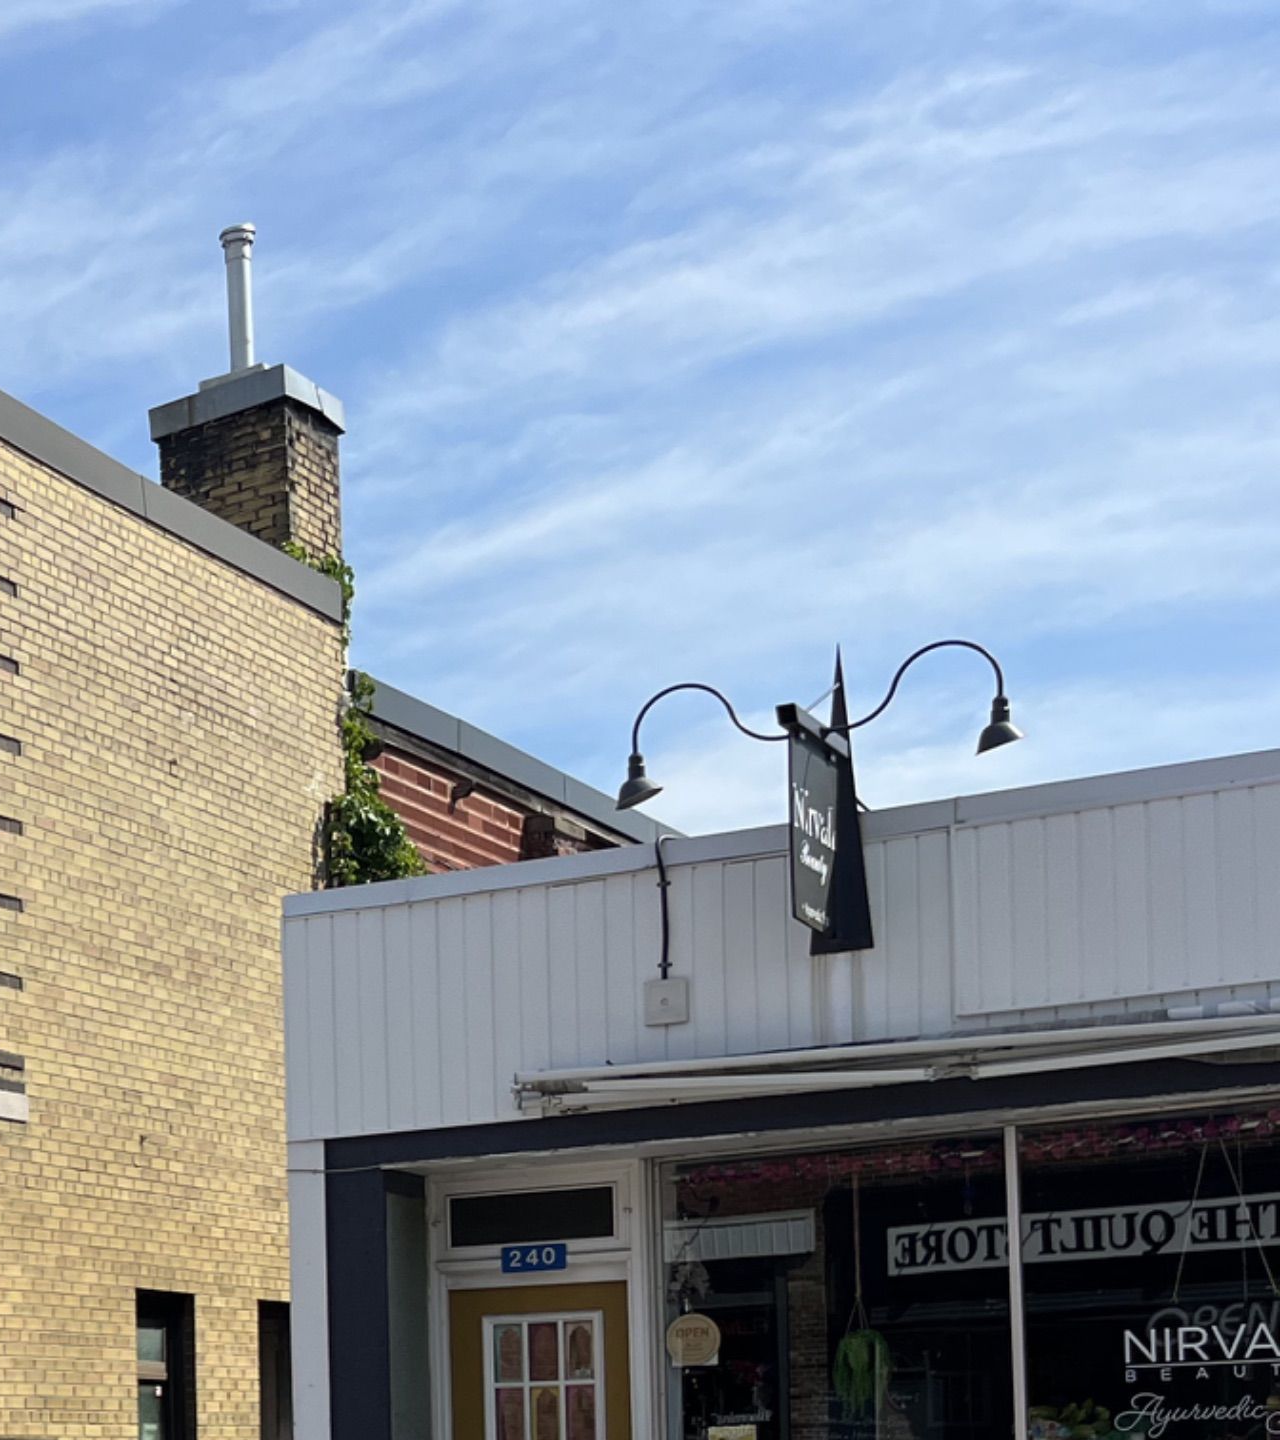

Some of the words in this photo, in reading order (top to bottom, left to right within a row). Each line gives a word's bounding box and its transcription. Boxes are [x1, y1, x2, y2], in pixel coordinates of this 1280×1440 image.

[509, 1246, 555, 1267] 240
[675, 1327, 709, 1338] OPEN
[1123, 1322, 1280, 1363] NIRVA
[1125, 1364, 1280, 1383] BEAUT
[1114, 1392, 1268, 1438] Ayurvedic
